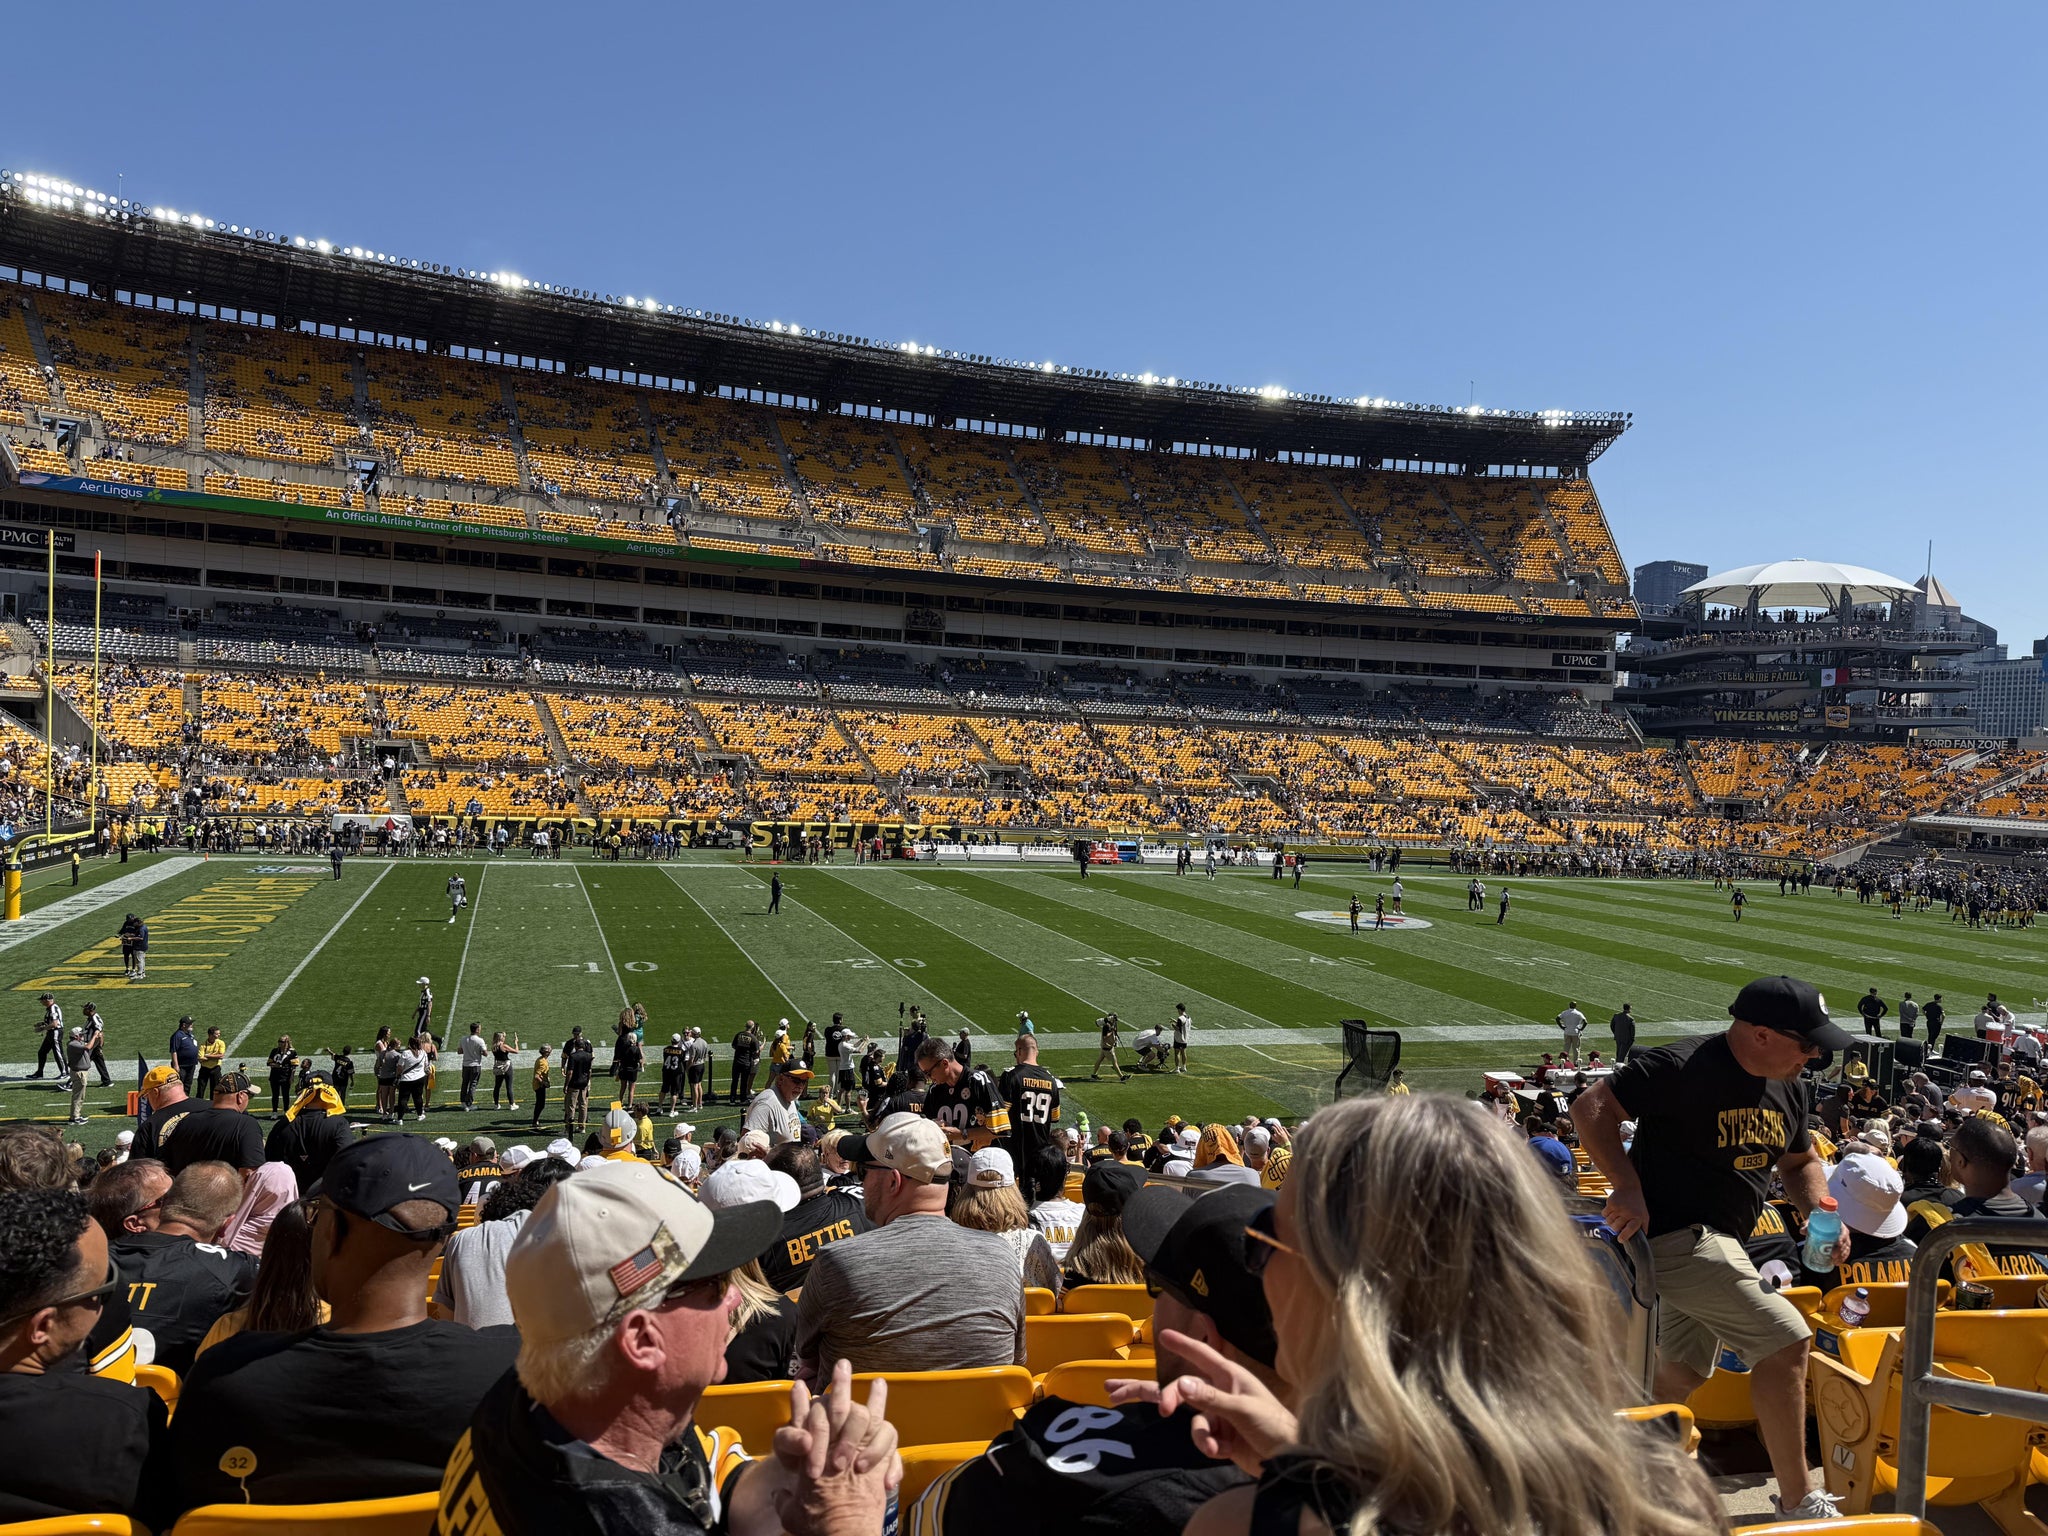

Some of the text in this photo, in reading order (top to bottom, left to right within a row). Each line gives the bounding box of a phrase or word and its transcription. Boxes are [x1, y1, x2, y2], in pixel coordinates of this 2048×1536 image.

[79, 481, 143, 499] Aer Lingus
[326, 509, 569, 543] An Official Airline Partner of the Pittsburgh Steelers
[0, 529, 39, 545] PMC
[626, 543, 675, 556] Aer Lingus
[1673, 565, 1692, 574] UPMC
[1496, 614, 1533, 624] Aer Lingus
[1562, 655, 1598, 666] UPMC
[1717, 671, 1804, 682] STEEL PRIDE FAMILY
[1714, 710, 1766, 722] YINZER
[1954, 739, 1975, 749] FAN
[1978, 740, 2008, 750] ZONE
[664, 1055, 679, 1069] 43
[1020, 1091, 1052, 1124] 39
[1553, 1096, 1569, 1113] 18
[1717, 1107, 1786, 1148] STEELERS
[1742, 1155, 1763, 1168] 1933
[786, 1219, 855, 1266] BETTIS
[228, 1456, 248, 1470] 32
[1840, 1447, 1850, 1465] V
